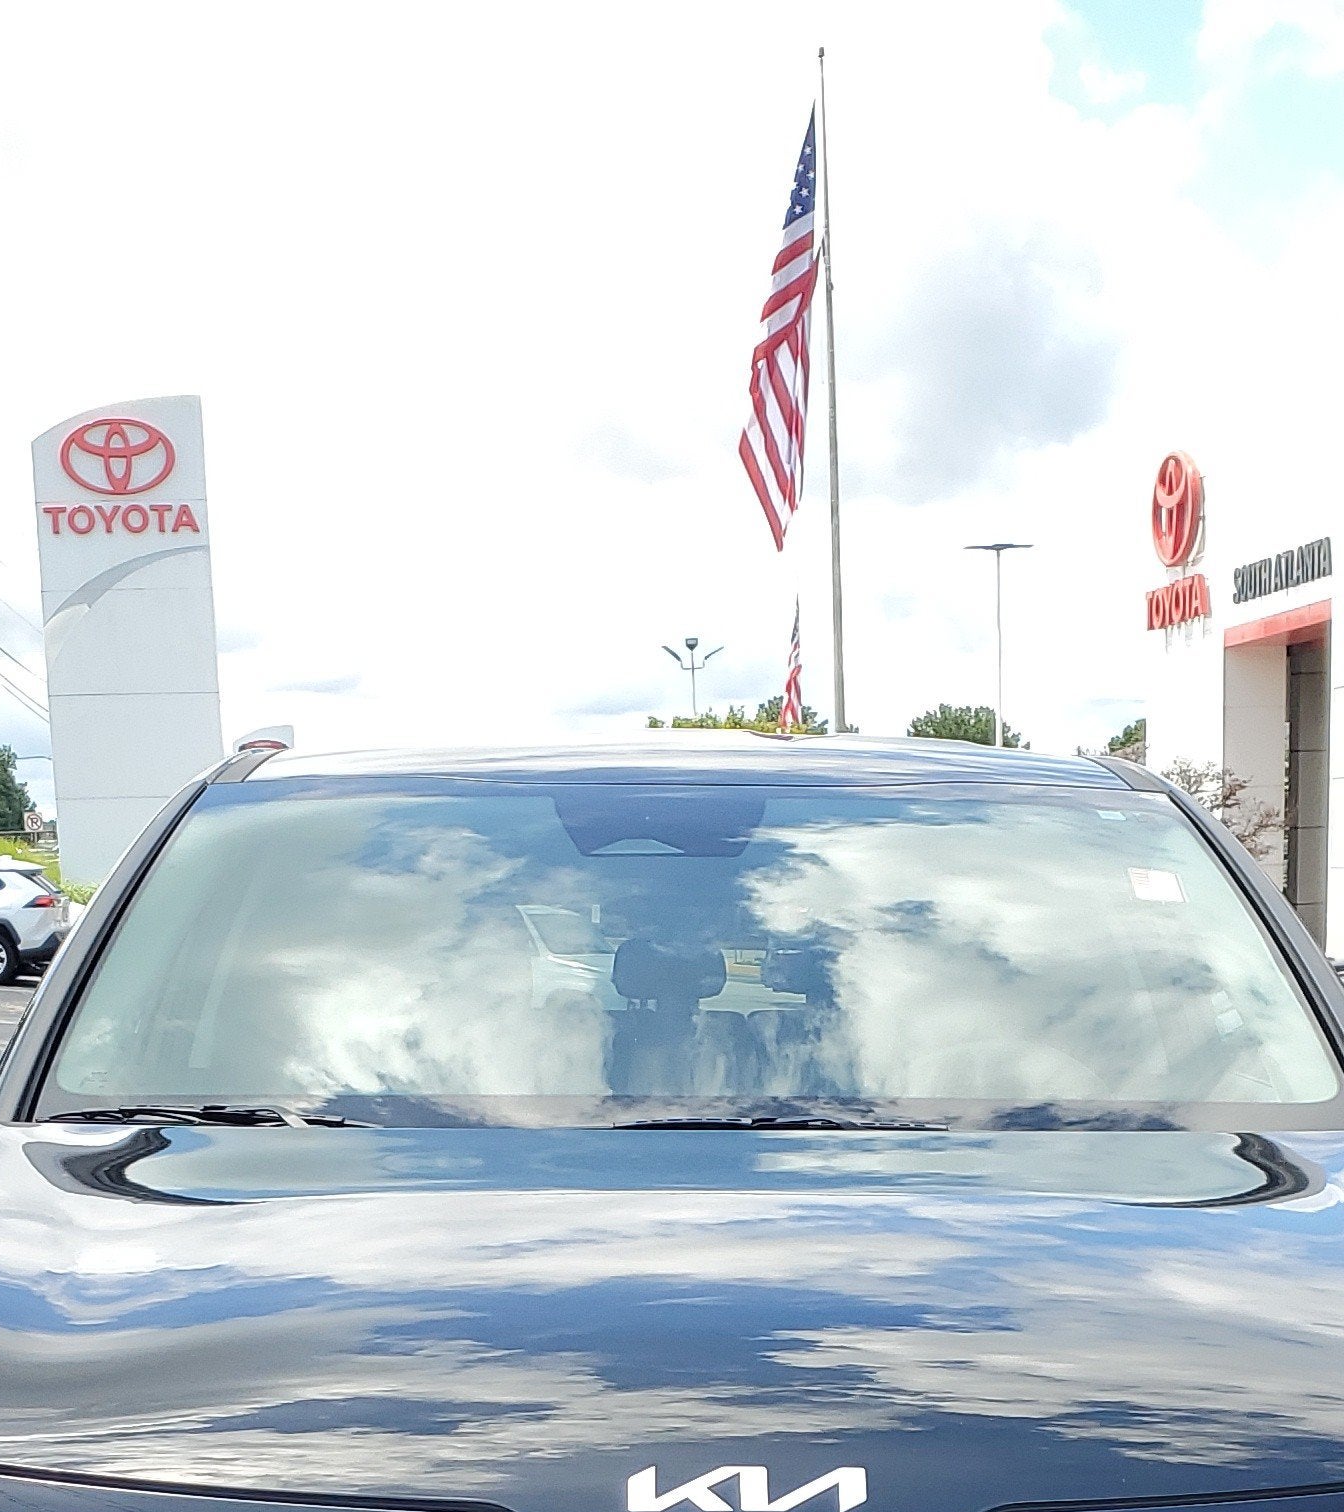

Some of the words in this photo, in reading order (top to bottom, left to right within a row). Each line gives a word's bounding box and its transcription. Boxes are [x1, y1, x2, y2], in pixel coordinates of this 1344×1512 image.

[43, 504, 200, 535] TOYOTA
[1233, 557, 1272, 604] SOUTH
[1275, 537, 1332, 592] ATLANTA
[1146, 573, 1211, 631] TOYOTA
